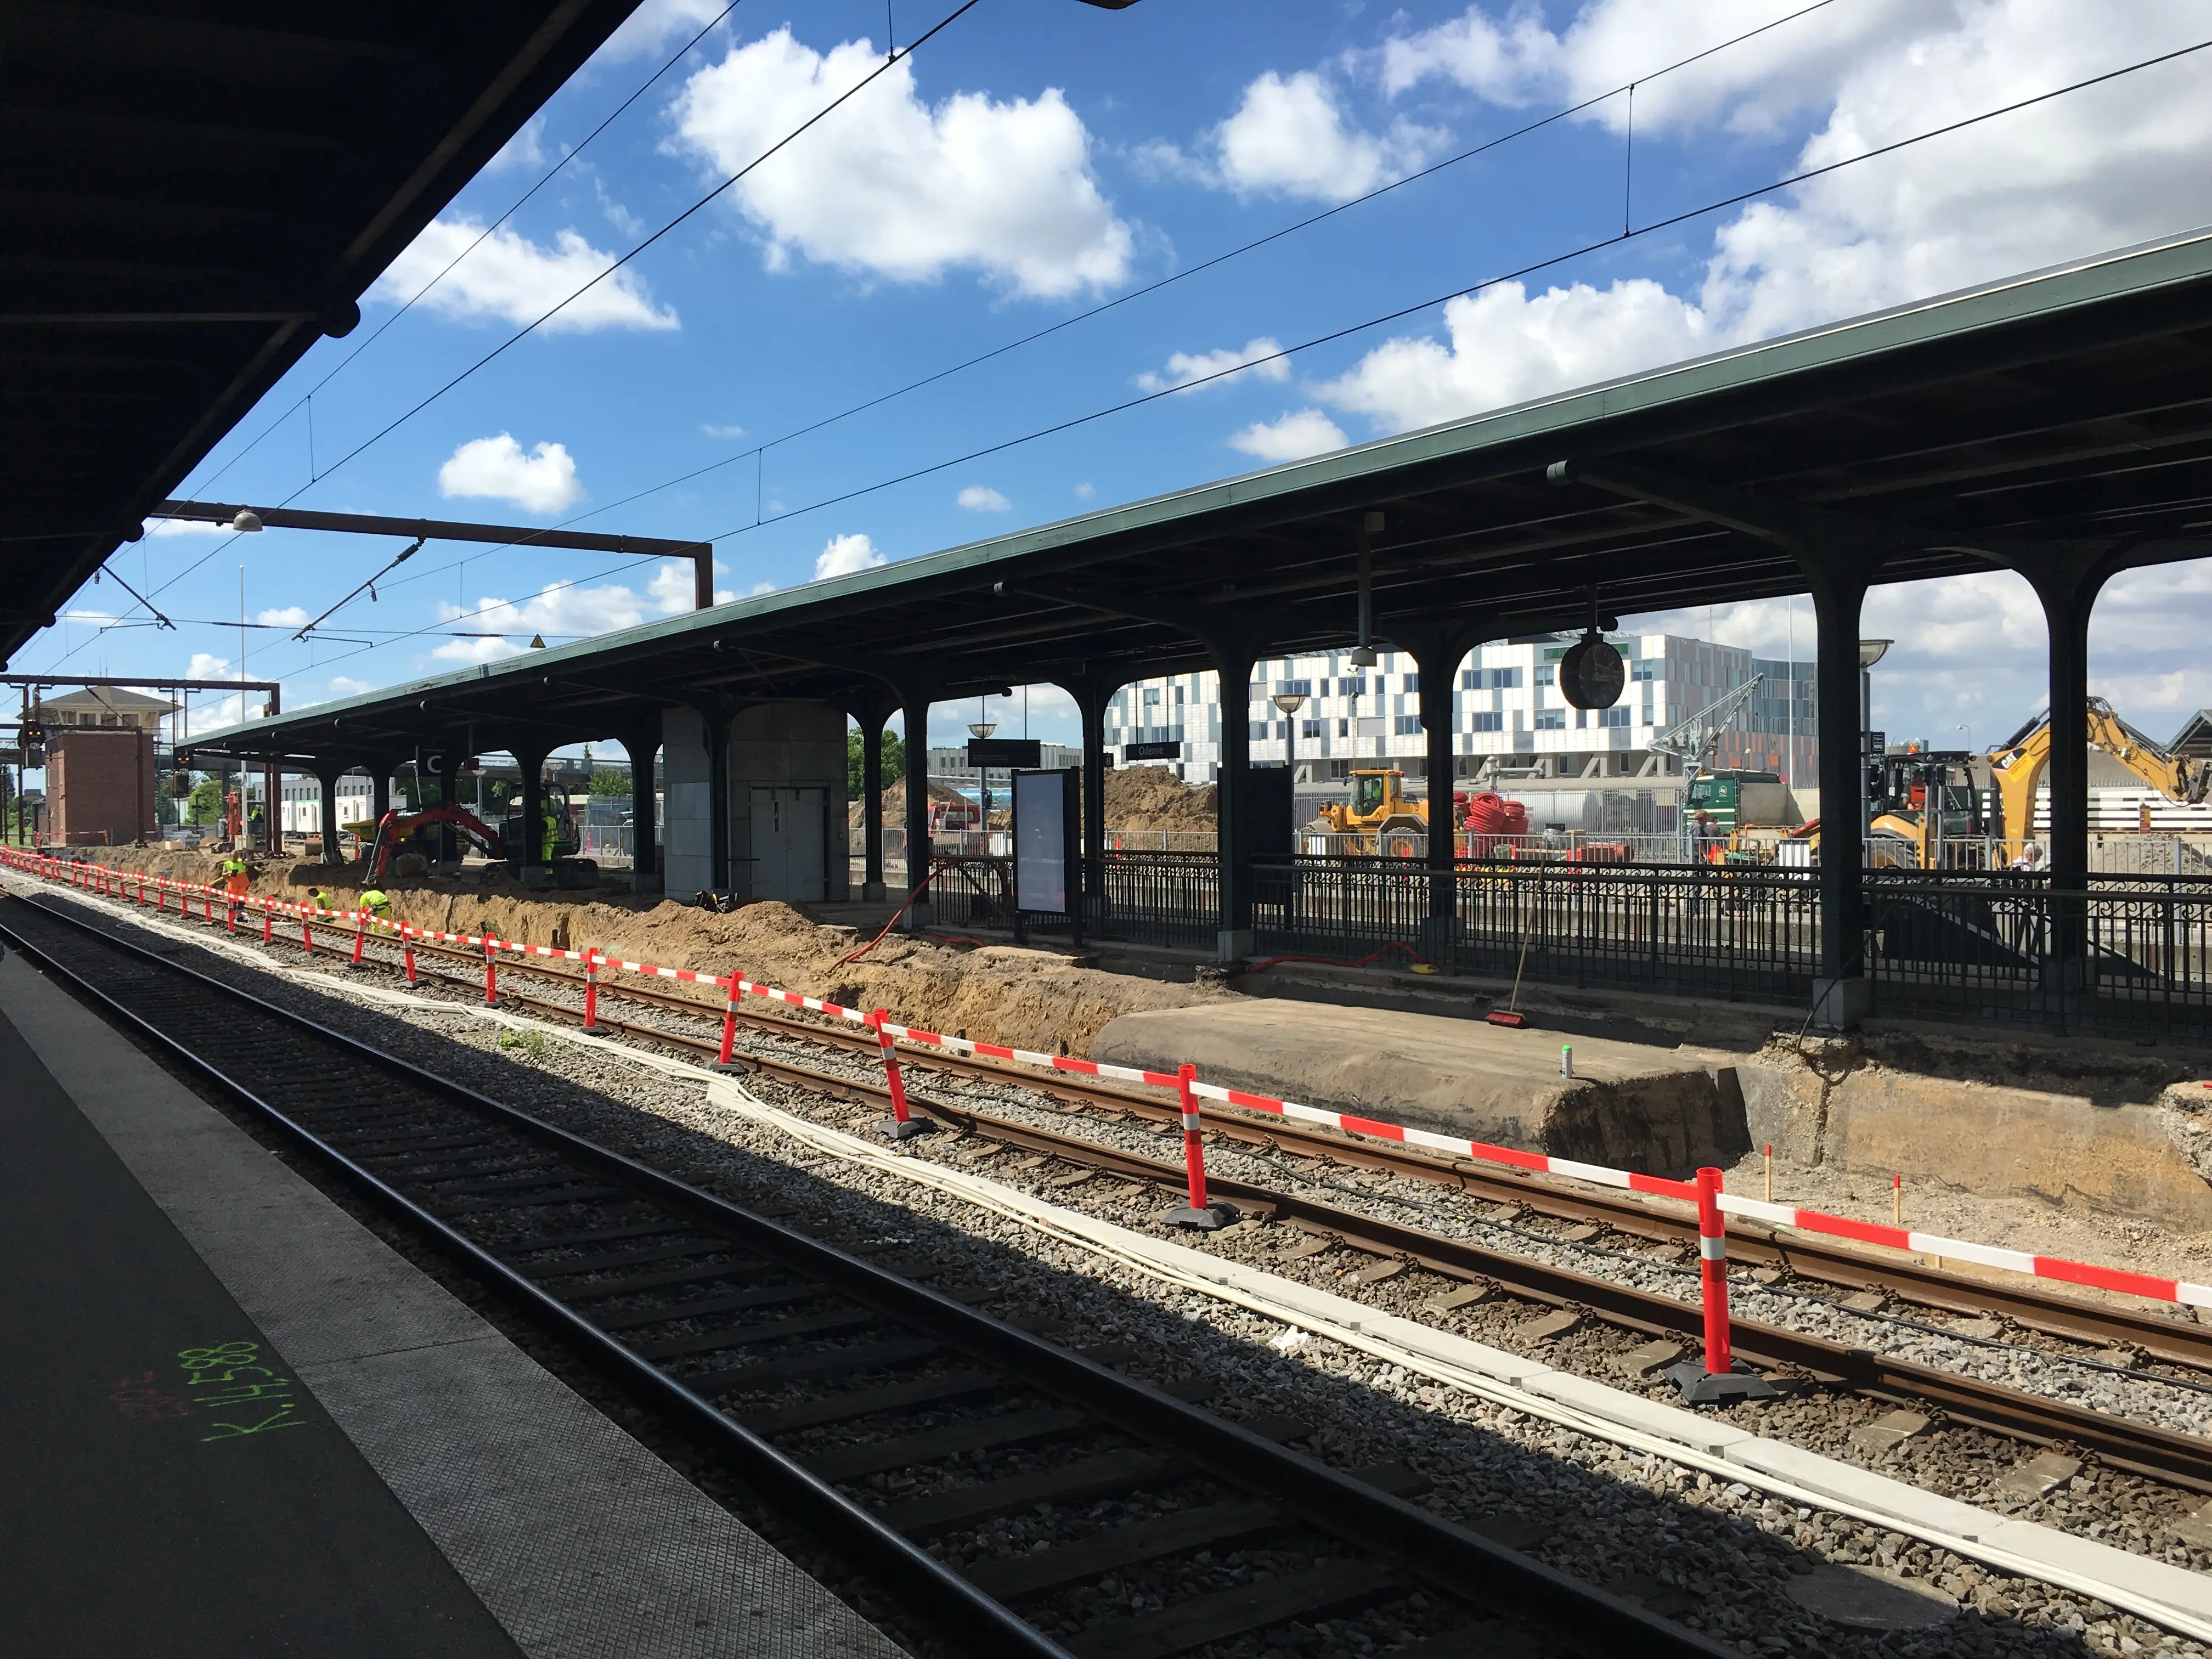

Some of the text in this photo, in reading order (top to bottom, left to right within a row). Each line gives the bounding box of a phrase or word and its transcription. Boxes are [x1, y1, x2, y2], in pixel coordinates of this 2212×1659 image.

[1139, 746, 1163, 755] Odense
[427, 755, 442, 774] C
[1106, 757, 1111, 765] 8
[2001, 752, 2017, 769] CAT
